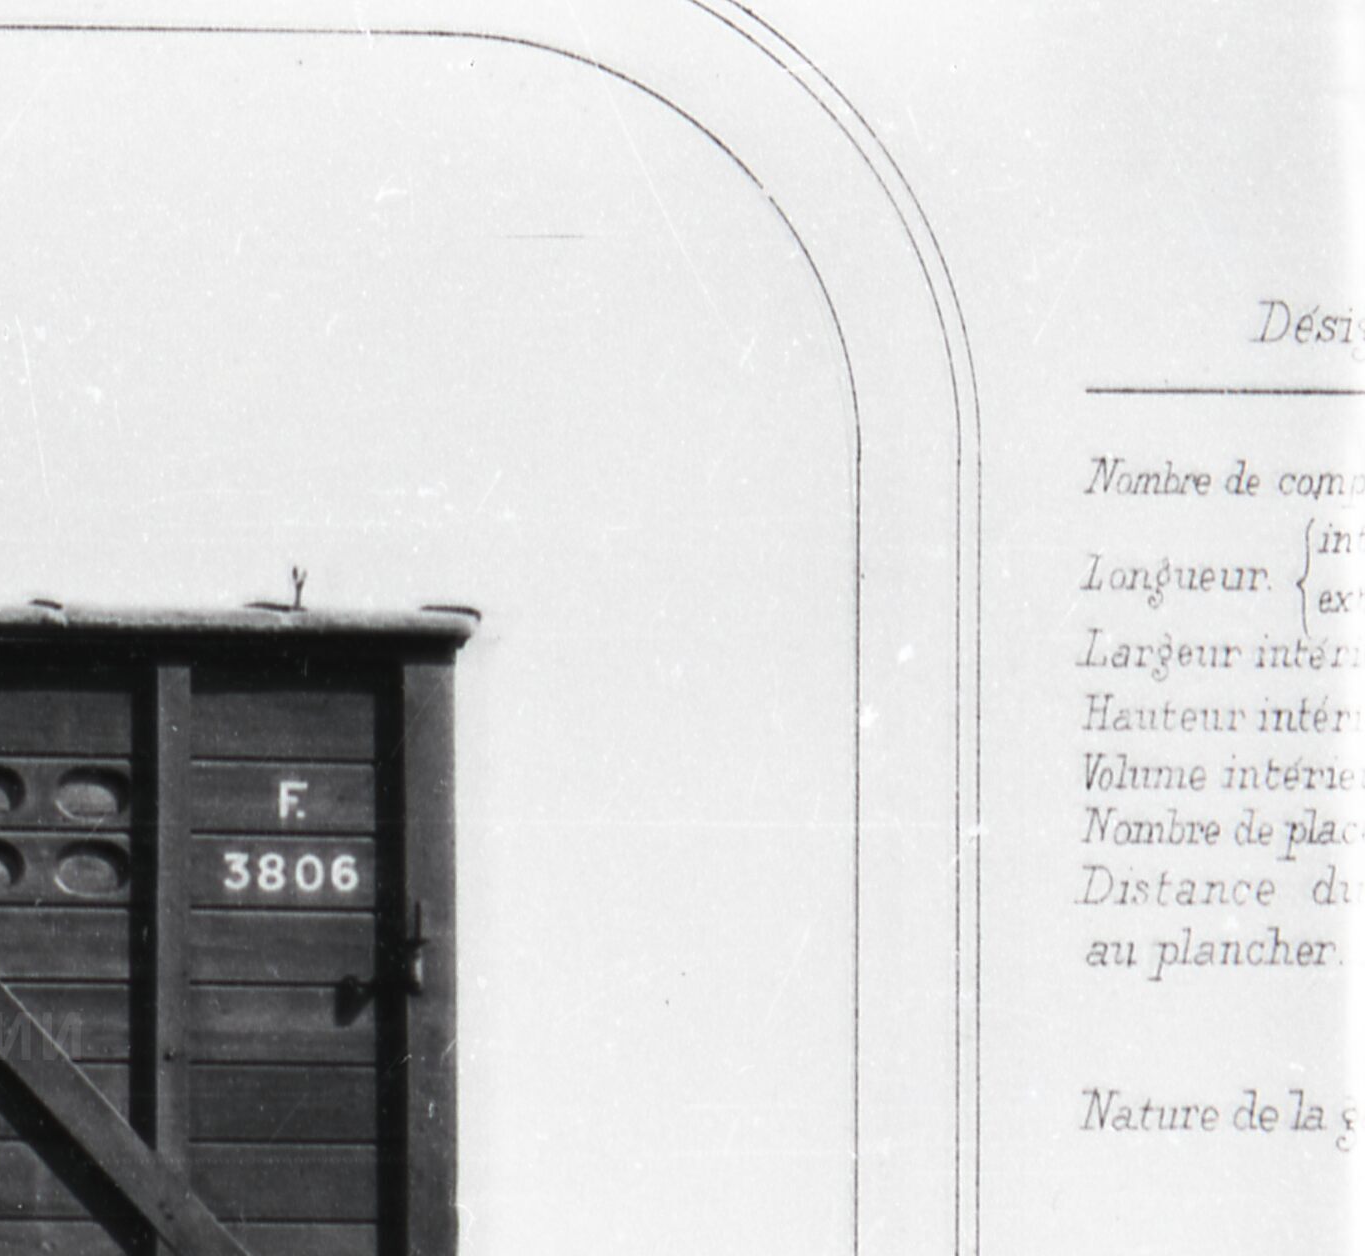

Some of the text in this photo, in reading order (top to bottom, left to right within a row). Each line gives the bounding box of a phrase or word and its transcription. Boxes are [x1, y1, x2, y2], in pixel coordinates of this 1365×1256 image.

[1083, 456, 1212, 497] Nombre
[1225, 460, 1261, 497] de
[1080, 553, 1273, 610] Longueur.
[1075, 627, 1242, 682] Largeur
[1081, 692, 1247, 733] Hauteur
[1081, 751, 1365, 792] Volume intérie
[279, 780, 308, 819] F.
[1081, 805, 1365, 862] Nombre de plac
[223, 852, 359, 892] 3806
[1074, 863, 1276, 907] Distance
[1085, 939, 1139, 969] au
[1080, 1087, 1221, 1133] Nature
[1233, 1088, 1280, 1133] de
[1288, 1088, 1328, 1132] la
